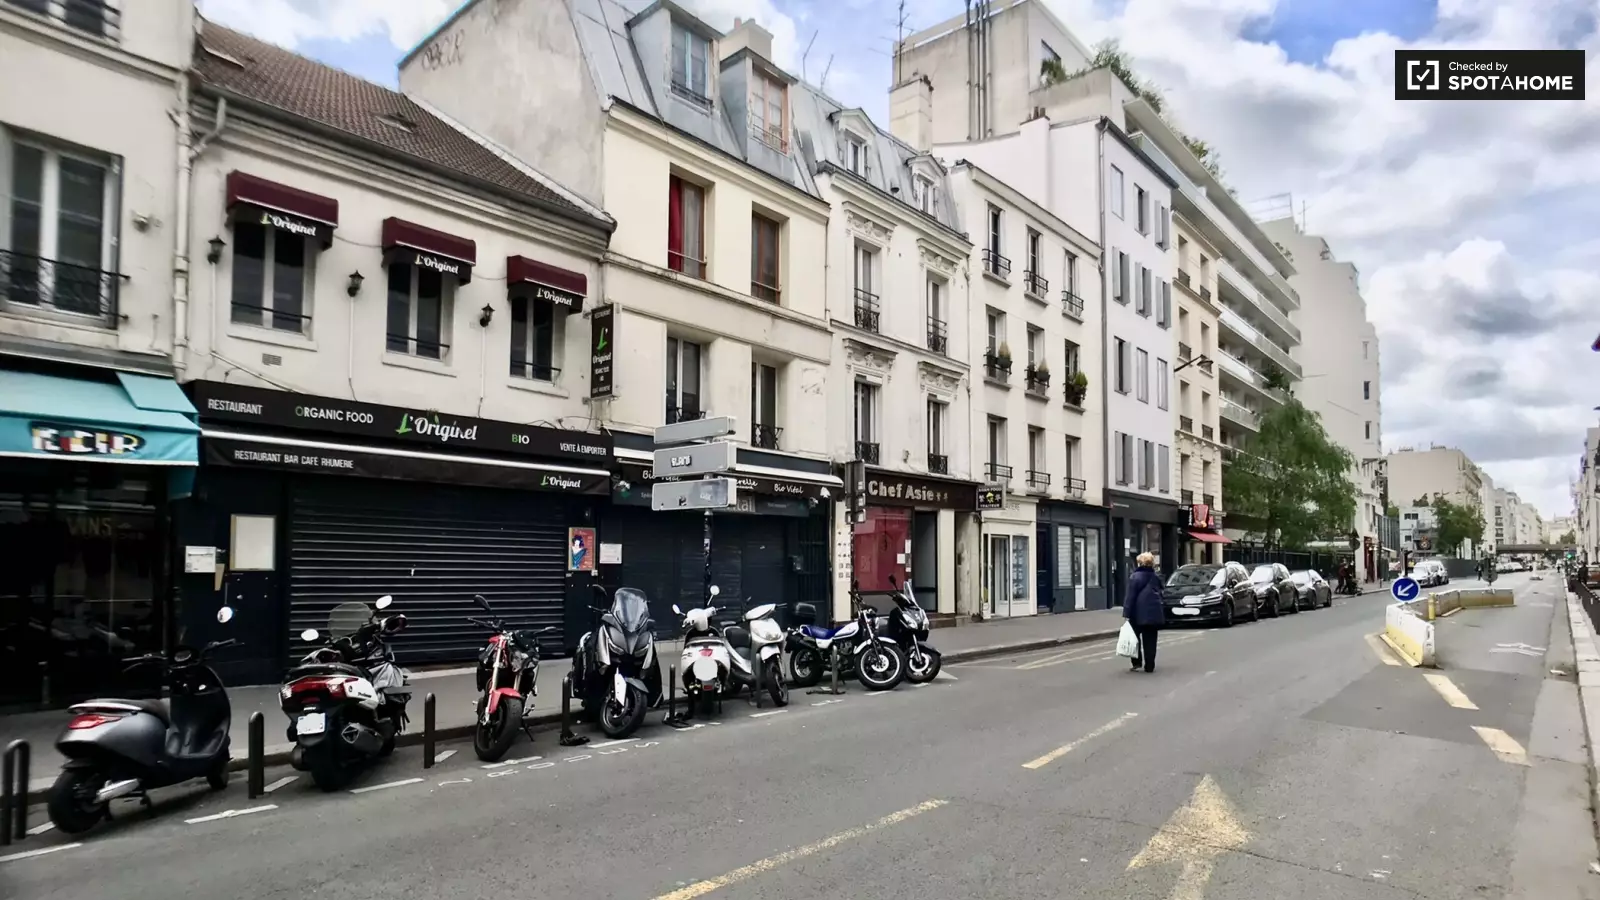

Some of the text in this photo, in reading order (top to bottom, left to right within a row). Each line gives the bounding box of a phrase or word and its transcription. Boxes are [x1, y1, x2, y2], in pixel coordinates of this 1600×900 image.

[208, 398, 263, 415] RESTAURANT
[295, 405, 374, 424] ORGANIC FOOD
[511, 433, 530, 445] BIO
[560, 442, 576, 453] VENTE
[581, 444, 607, 456] EMPORTER
[234, 450, 281, 463] RESTAURANT
[284, 455, 299, 464] BAR
[321, 457, 354, 469] RHUMERIE
[774, 483, 804, 494] Bio Vital
[868, 480, 903, 498] Chef
[905, 485, 934, 501] Asie
